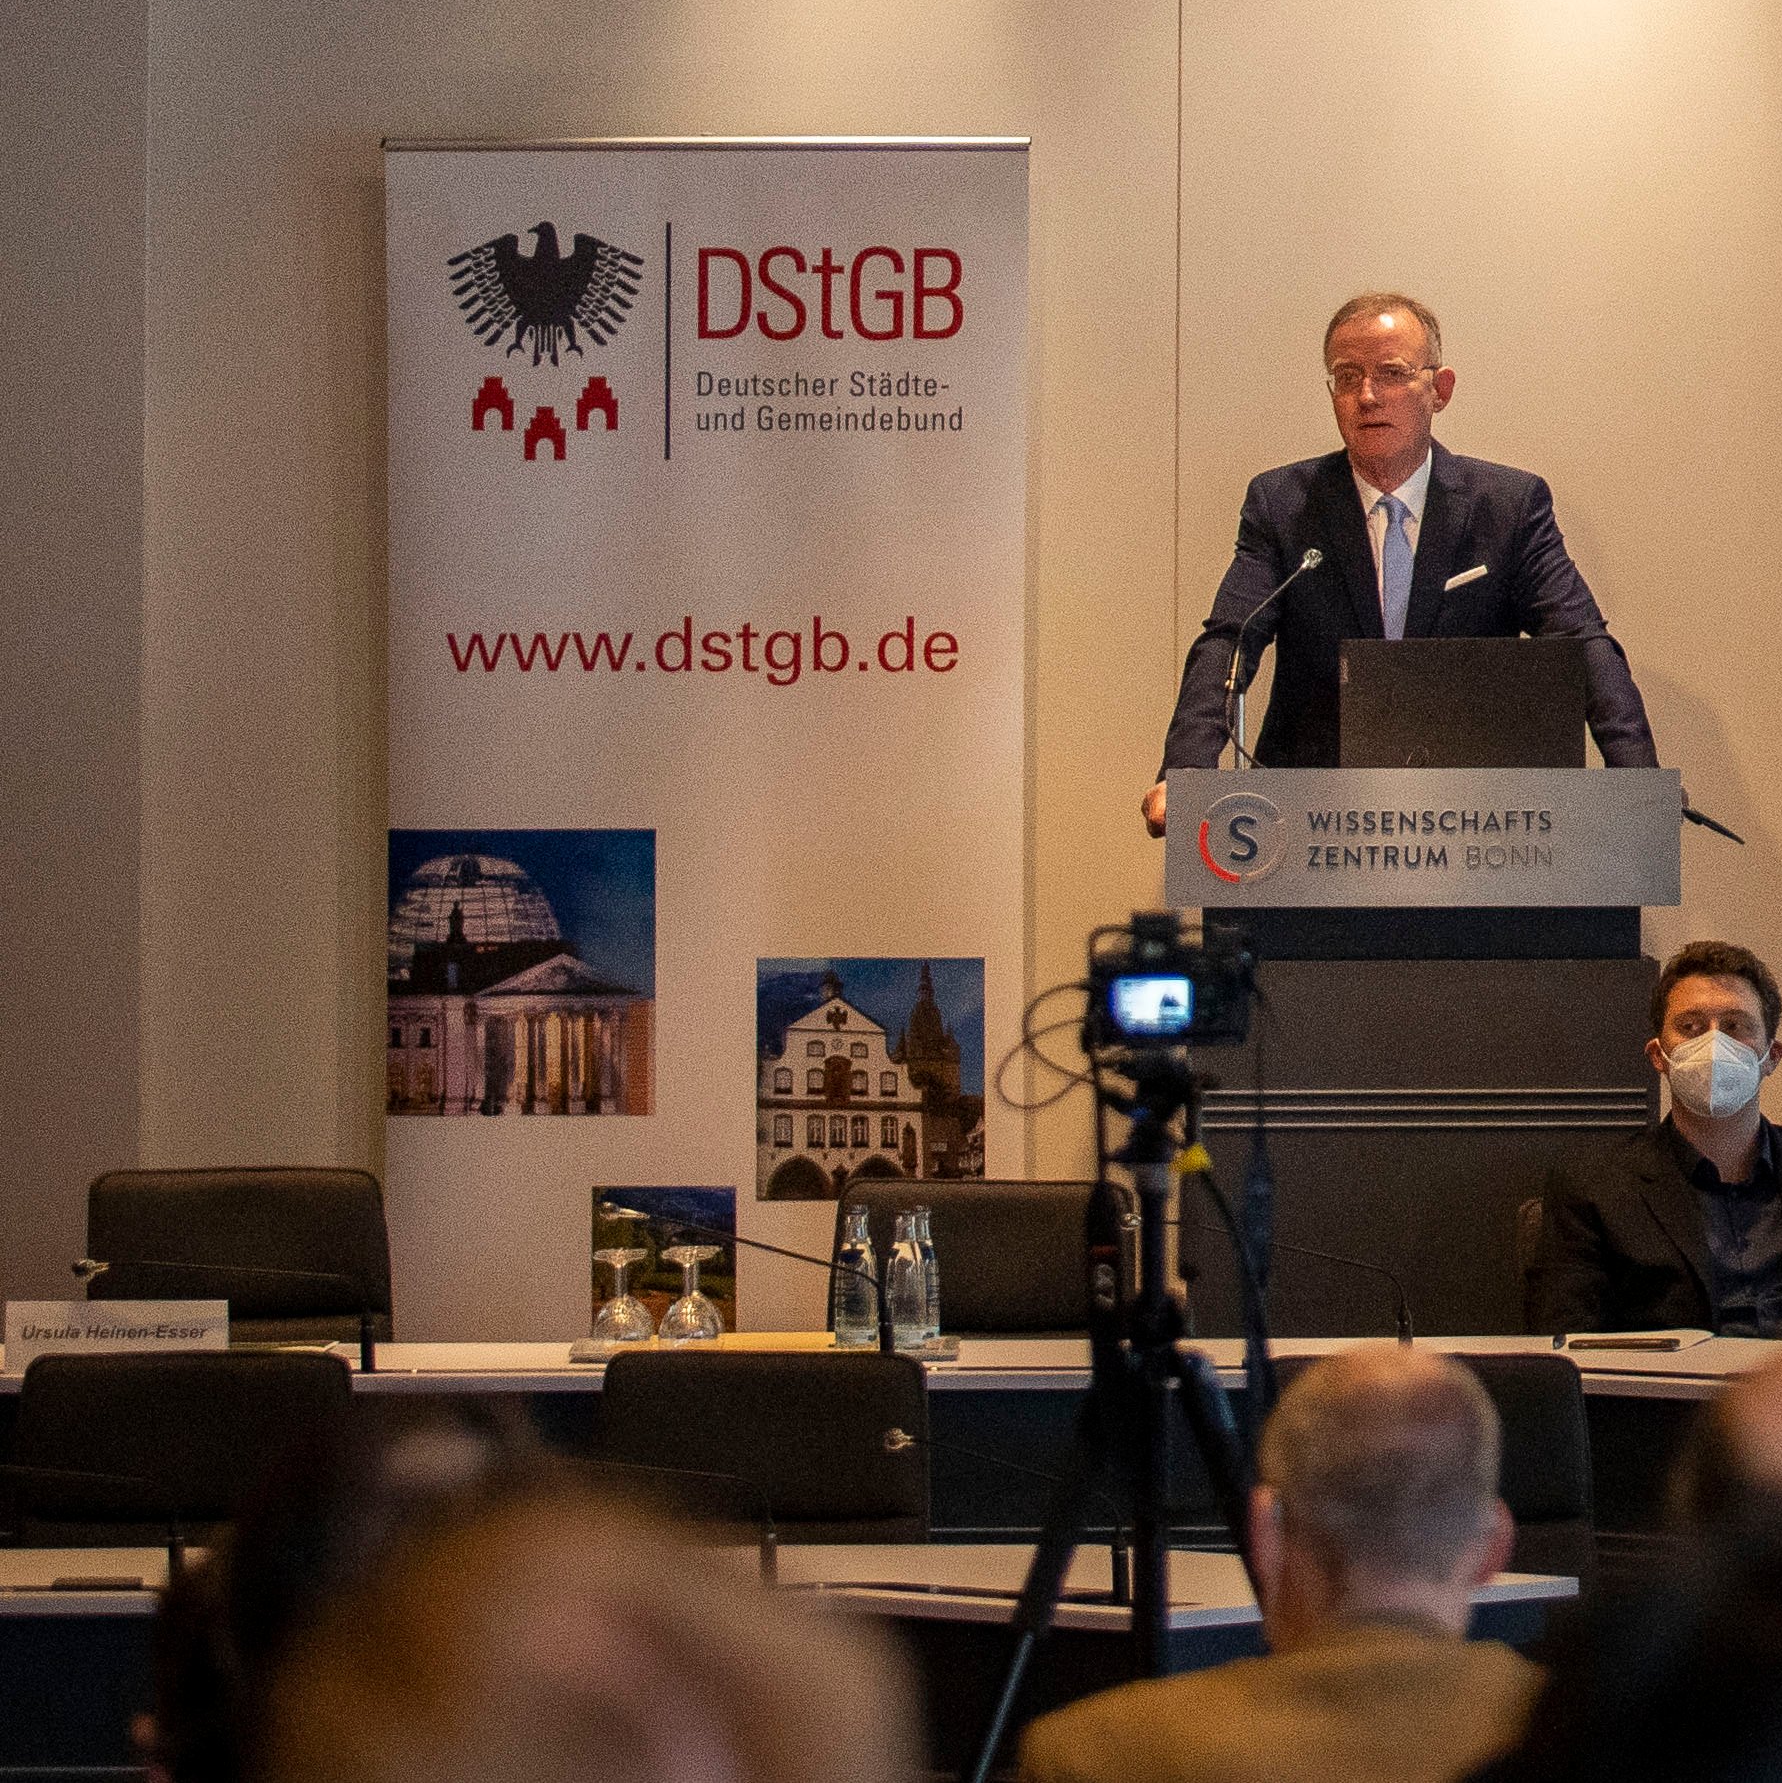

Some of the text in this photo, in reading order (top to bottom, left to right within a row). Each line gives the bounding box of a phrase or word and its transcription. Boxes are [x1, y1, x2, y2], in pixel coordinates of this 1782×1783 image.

[697, 245, 964, 342] DStGB
[696, 369, 950, 398] Deutscher Städte-
[695, 405, 964, 433] und Gemeindebund
[445, 616, 960, 687] www.dstgb.de
[1307, 809, 1553, 833] WISSENSCHAFTS
[1307, 845, 1553, 869] ZENTRUM BONN
[21, 1324, 209, 1341] Ursula Heinen-Esser
